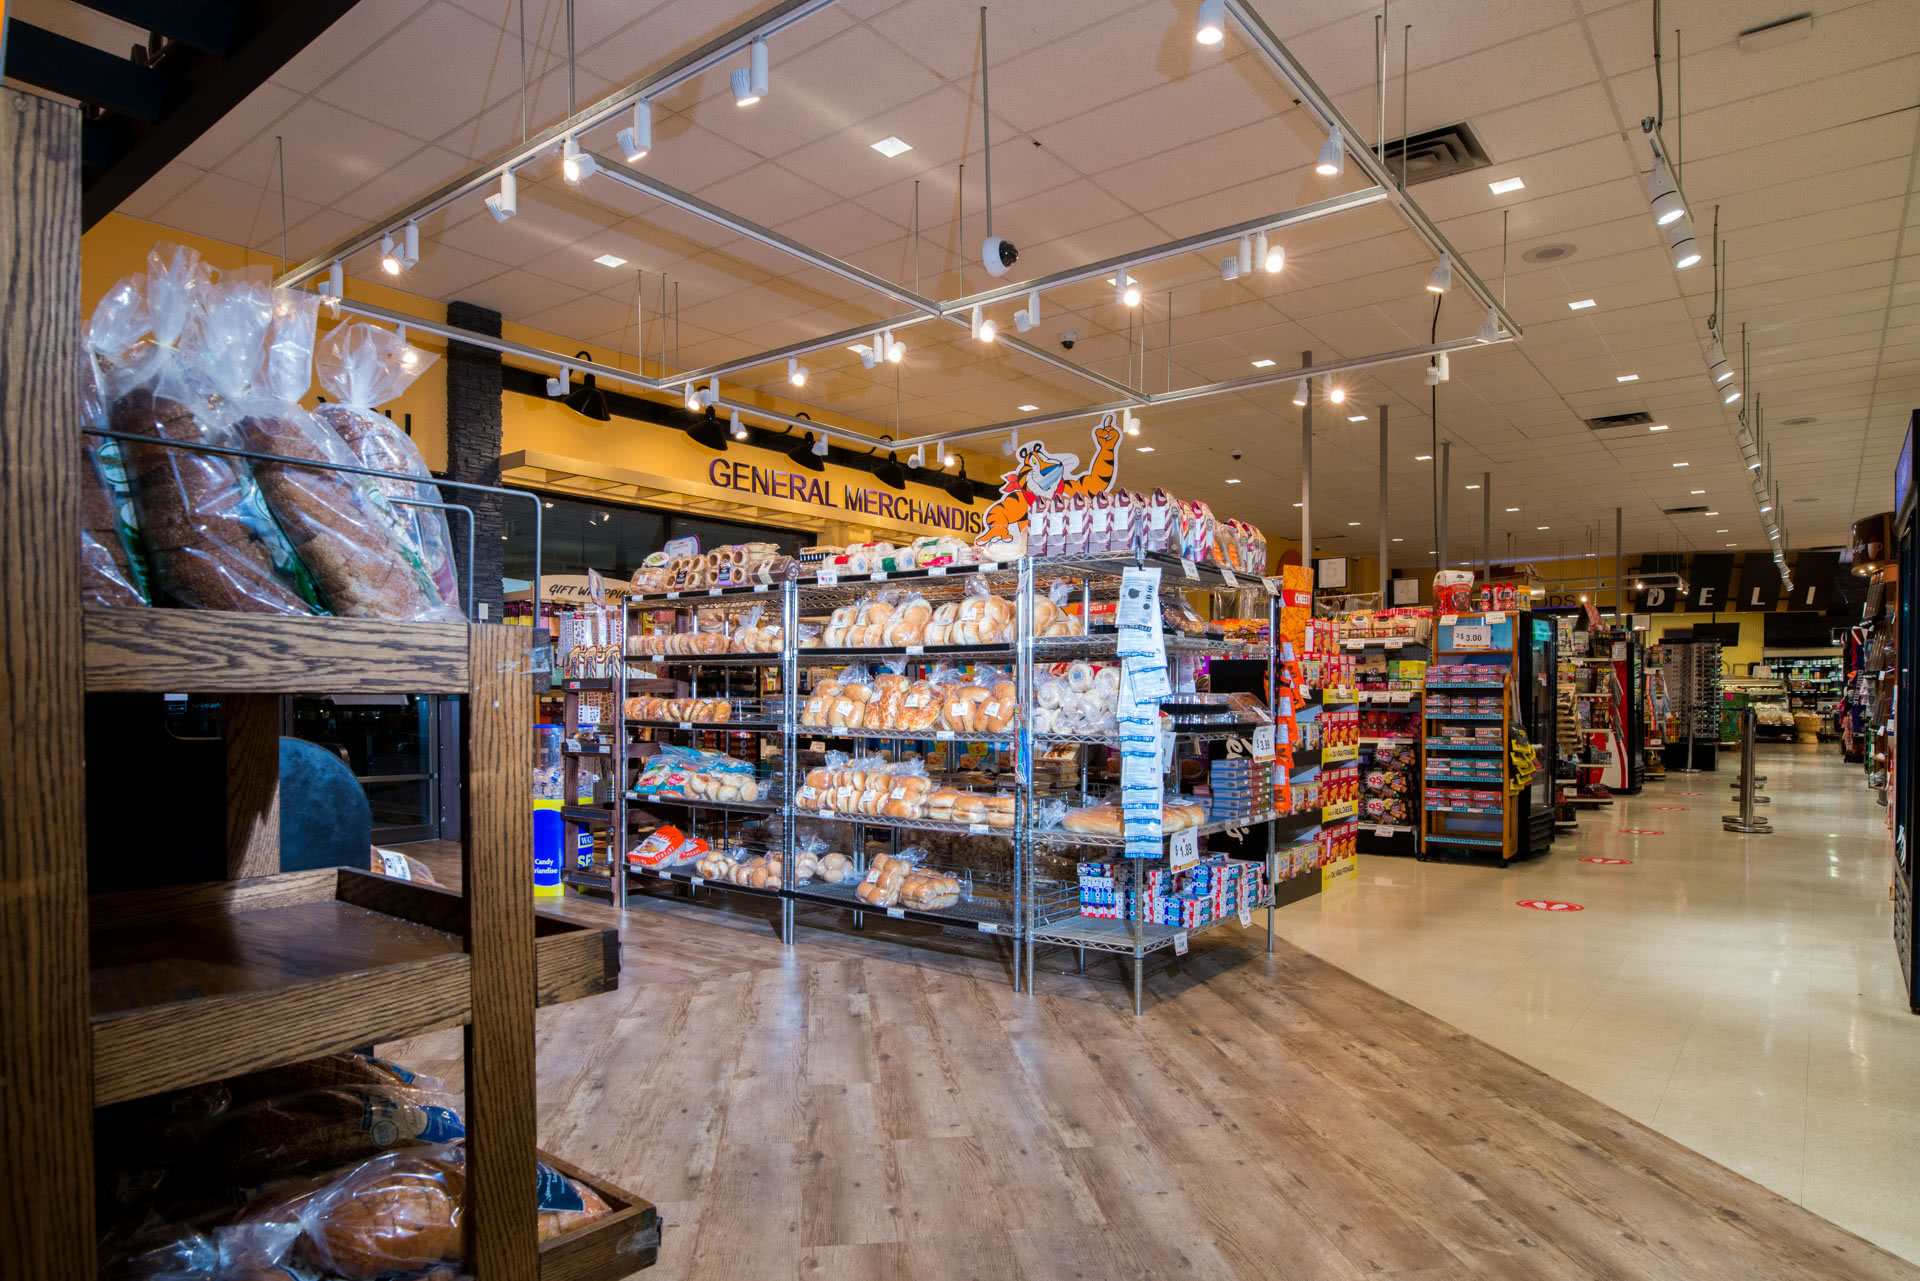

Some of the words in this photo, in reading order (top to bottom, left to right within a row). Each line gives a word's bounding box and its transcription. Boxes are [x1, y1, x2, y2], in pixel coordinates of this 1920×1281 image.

[708, 458, 837, 508] GENERAL
[844, 484, 986, 534] MERCHANDIS
[549, 584, 577, 596] GIFT
[1646, 586, 1817, 607] DELI
[1465, 634, 1482, 642] 3.00
[1377, 749, 1391, 757] 95
[1369, 776, 1383, 785] 95
[1368, 802, 1382, 811] 95
[1180, 843, 1193, 858] 1.89
[534, 858, 554, 867] Candy
